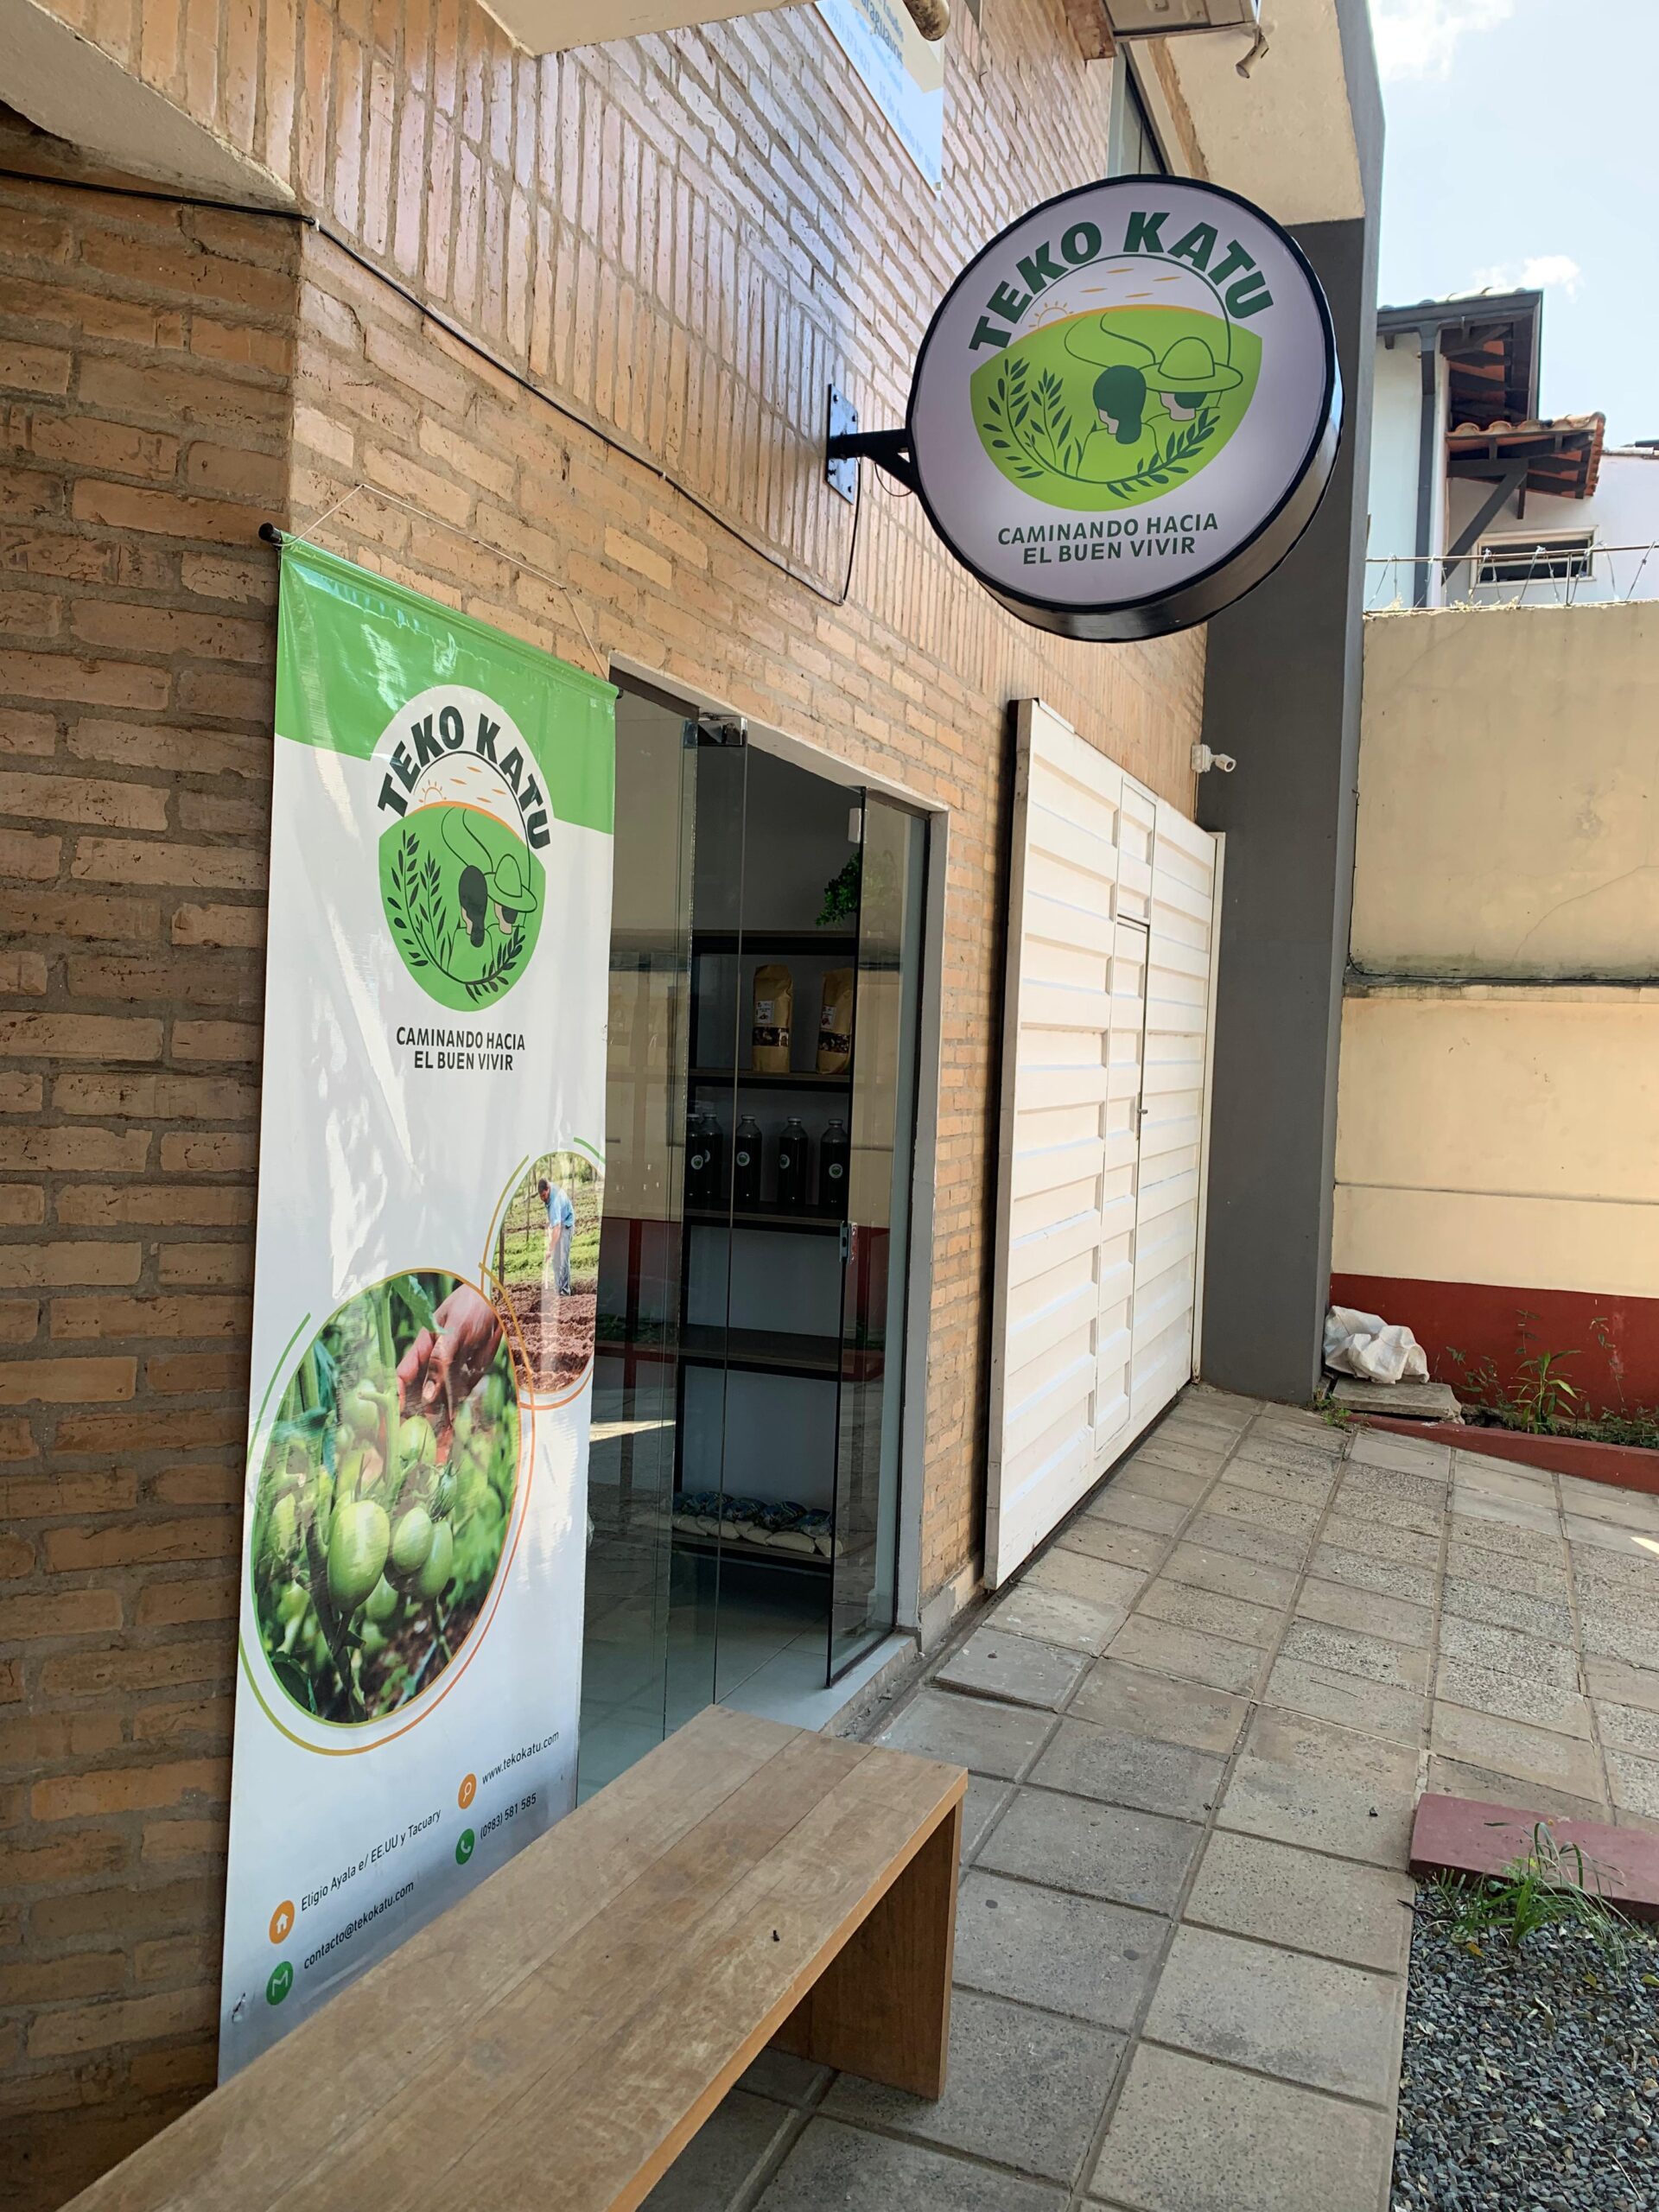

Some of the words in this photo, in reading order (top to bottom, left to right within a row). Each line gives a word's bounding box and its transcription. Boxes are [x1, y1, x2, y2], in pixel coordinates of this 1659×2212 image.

[969, 221, 1103, 352] TEKO
[1123, 211, 1274, 320] KATU
[998, 518, 1139, 545] CAMINANDO
[1147, 512, 1218, 535] HACIA
[1023, 547, 1052, 564] EL
[1058, 541, 1122, 562] BUEN
[1130, 537, 1196, 557] VIVIR
[377, 705, 465, 817] TEKO
[476, 713, 551, 850] KATU
[396, 1027, 483, 1048] CAMINANDO
[486, 1033, 525, 1051] HACIA
[414, 1051, 434, 1069] EL
[437, 1052, 474, 1070] BUEN
[478, 1053, 513, 1071] VIVIR
[482, 1731, 559, 1784] www.tekokatu.com
[480, 1812, 503, 1840] (0983)
[505, 1803, 518, 1821] 581
[520, 1792, 537, 1810] 585
[301, 1885, 328, 1911] Eligio
[330, 1866, 356, 1891] Ayala
[358, 1853, 369, 1872] e/
[371, 1834, 398, 1863] EE.UU
[400, 1832, 406, 1847] y
[408, 1809, 442, 1838] Tacuary
[303, 1882, 415, 1969] contacto@tekokatu.com
